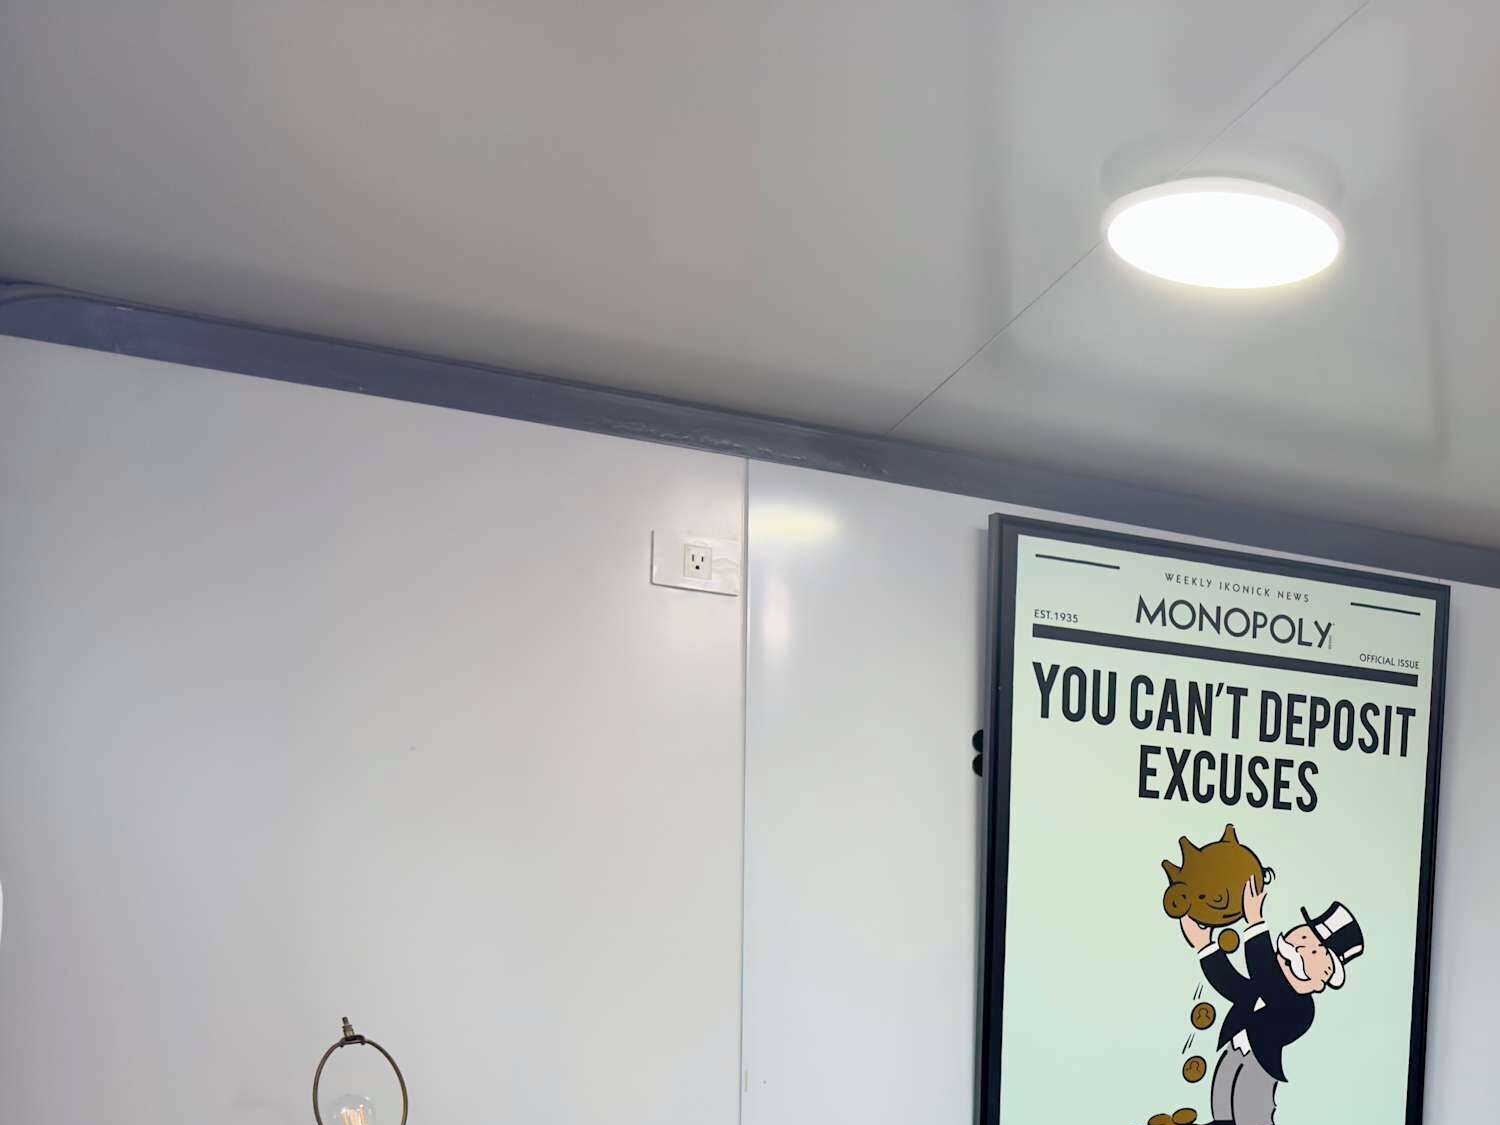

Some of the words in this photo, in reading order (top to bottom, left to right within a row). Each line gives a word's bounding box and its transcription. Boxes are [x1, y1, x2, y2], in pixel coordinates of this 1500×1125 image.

[1165, 573, 1212, 588] WEEKLY
[1219, 581, 1270, 597] IKONICK
[1277, 591, 1310, 603] NEWS
[1135, 594, 1332, 649] MONOPOLY
[1359, 653, 1395, 666] OFFICIAL
[1397, 659, 1420, 669] ISSUE
[1032, 661, 1118, 726] YOU
[1129, 674, 1249, 740] CAN'T
[1258, 689, 1417, 758] DEPOSIT
[1138, 744, 1319, 813] EXCUSES
